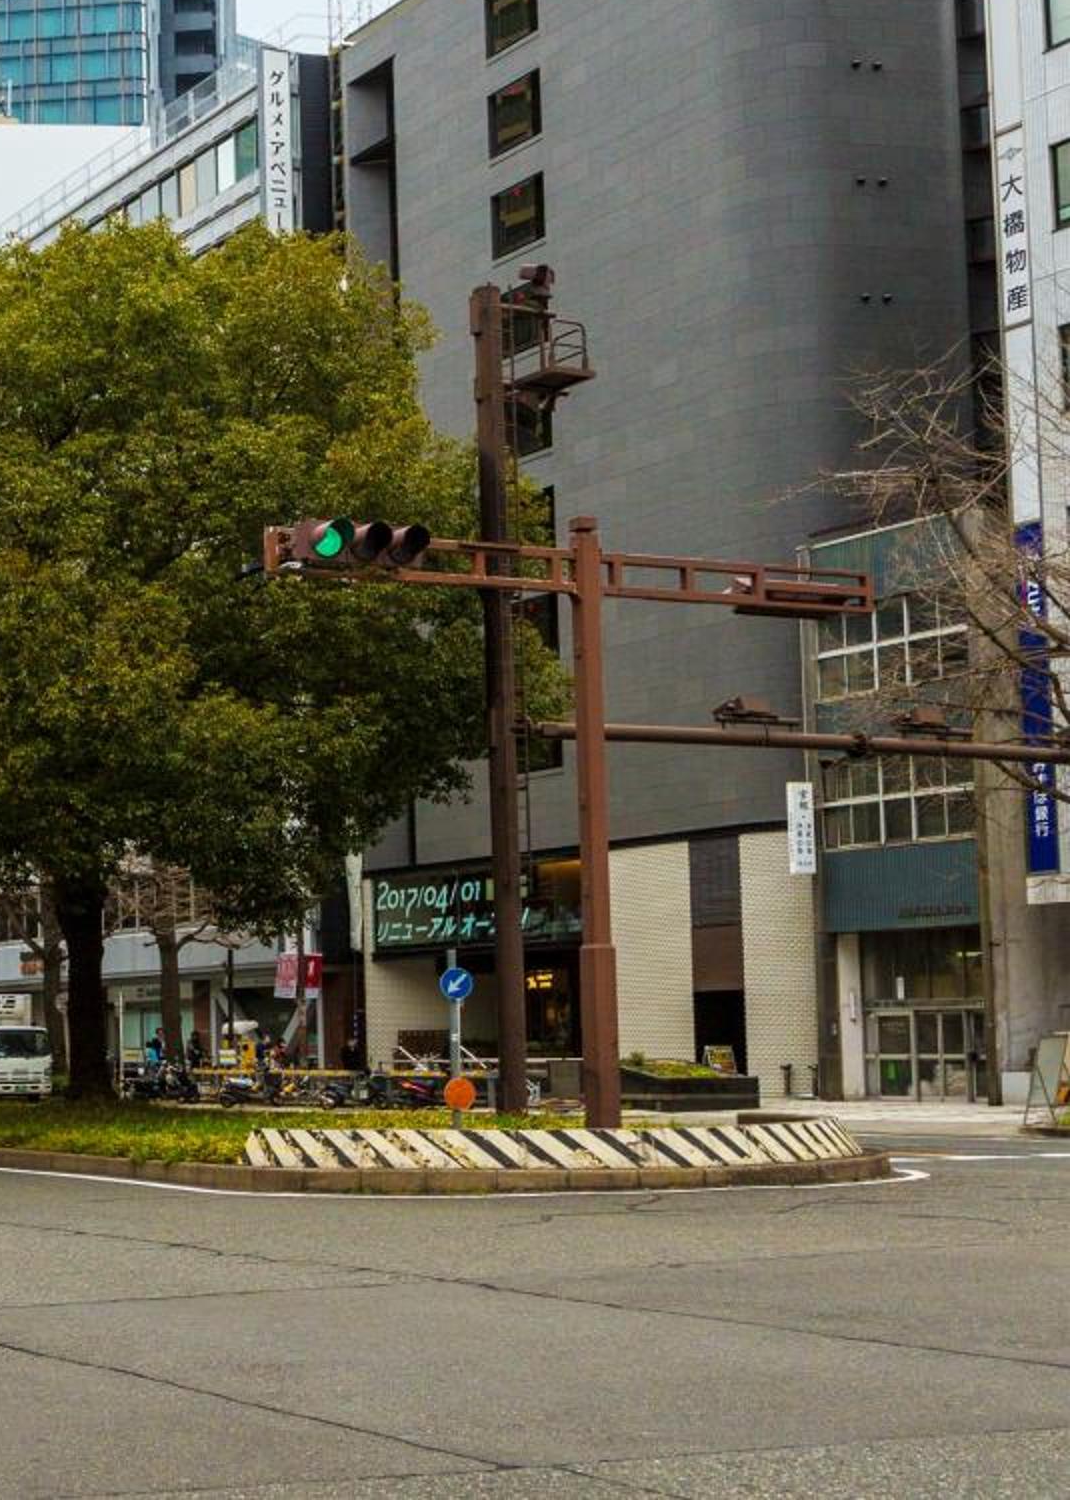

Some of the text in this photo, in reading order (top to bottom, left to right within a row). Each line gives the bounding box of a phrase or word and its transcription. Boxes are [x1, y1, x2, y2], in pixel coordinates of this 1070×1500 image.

[269, 70, 288, 229] グルメ・アベニュー
[1001, 175, 1028, 312] 大橋物産
[377, 915, 456, 943] リニューアル
